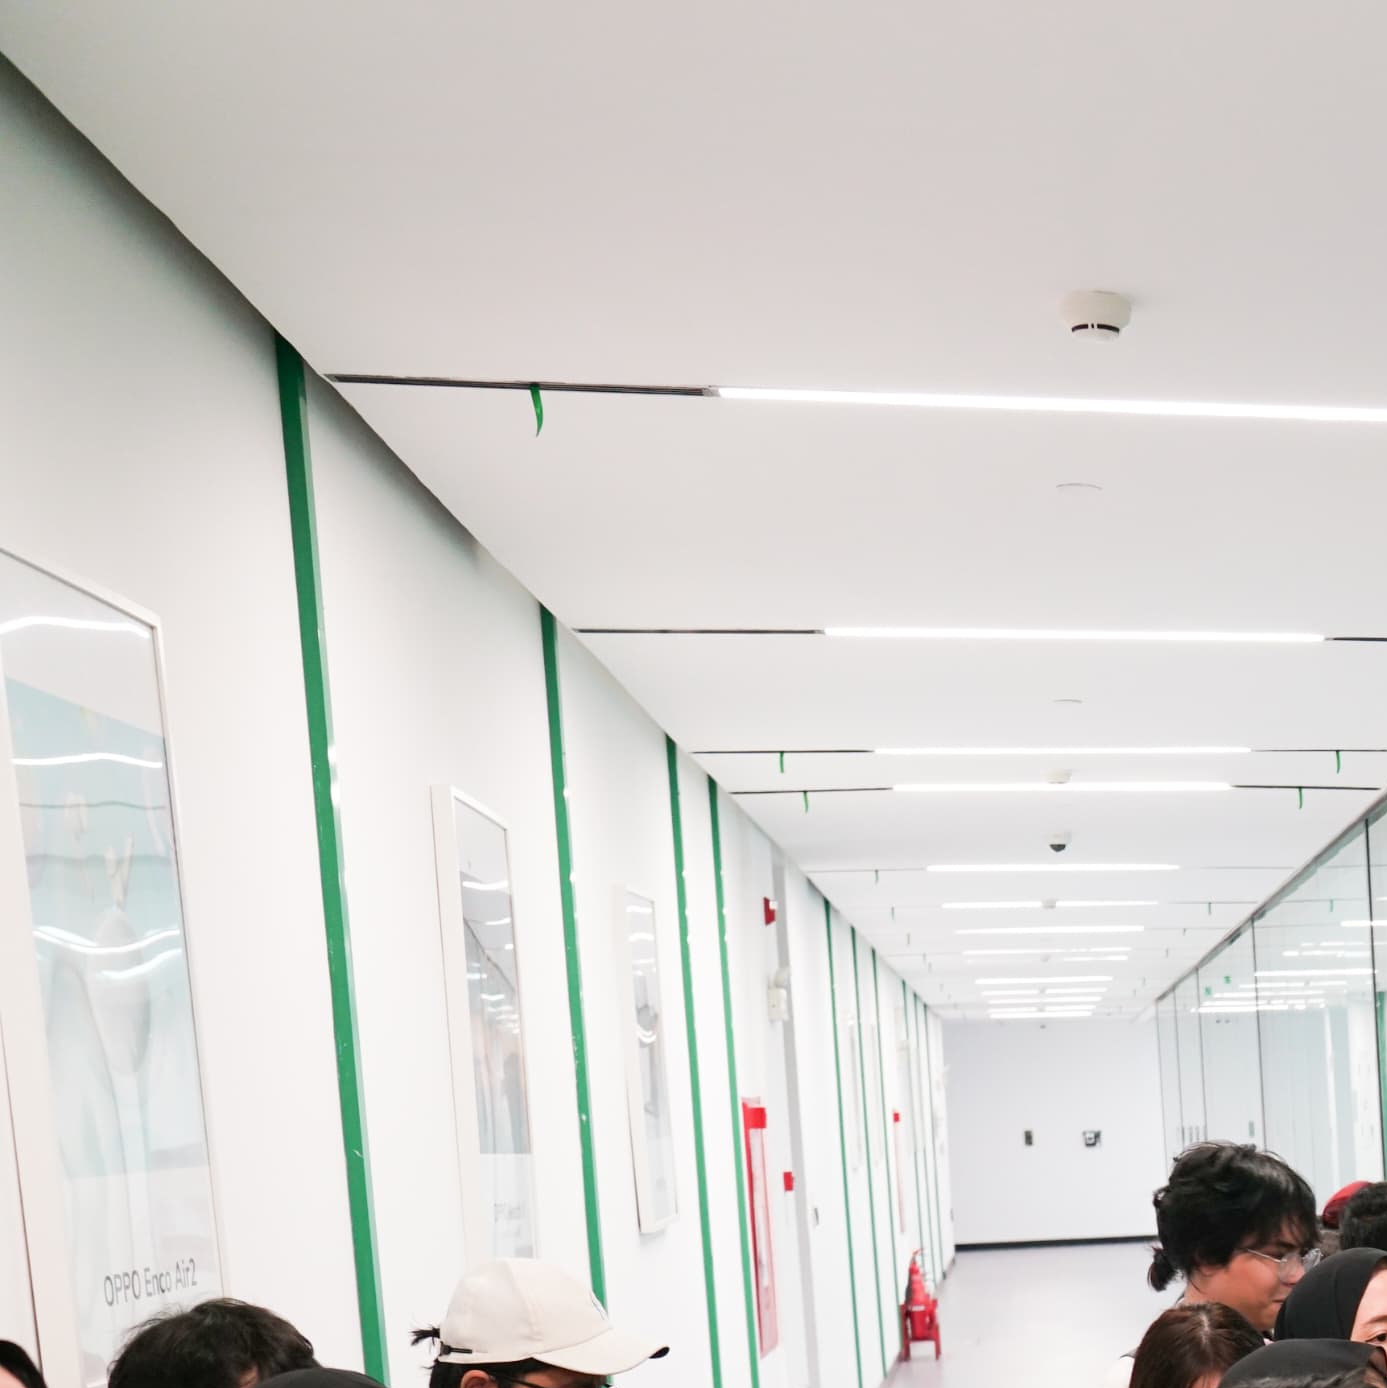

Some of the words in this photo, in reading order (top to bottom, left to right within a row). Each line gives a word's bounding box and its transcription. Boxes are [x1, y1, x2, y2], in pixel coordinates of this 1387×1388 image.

[103, 1270, 141, 1307] OPPO
[144, 1267, 172, 1297] Enco
[175, 1257, 198, 1290] Air2
